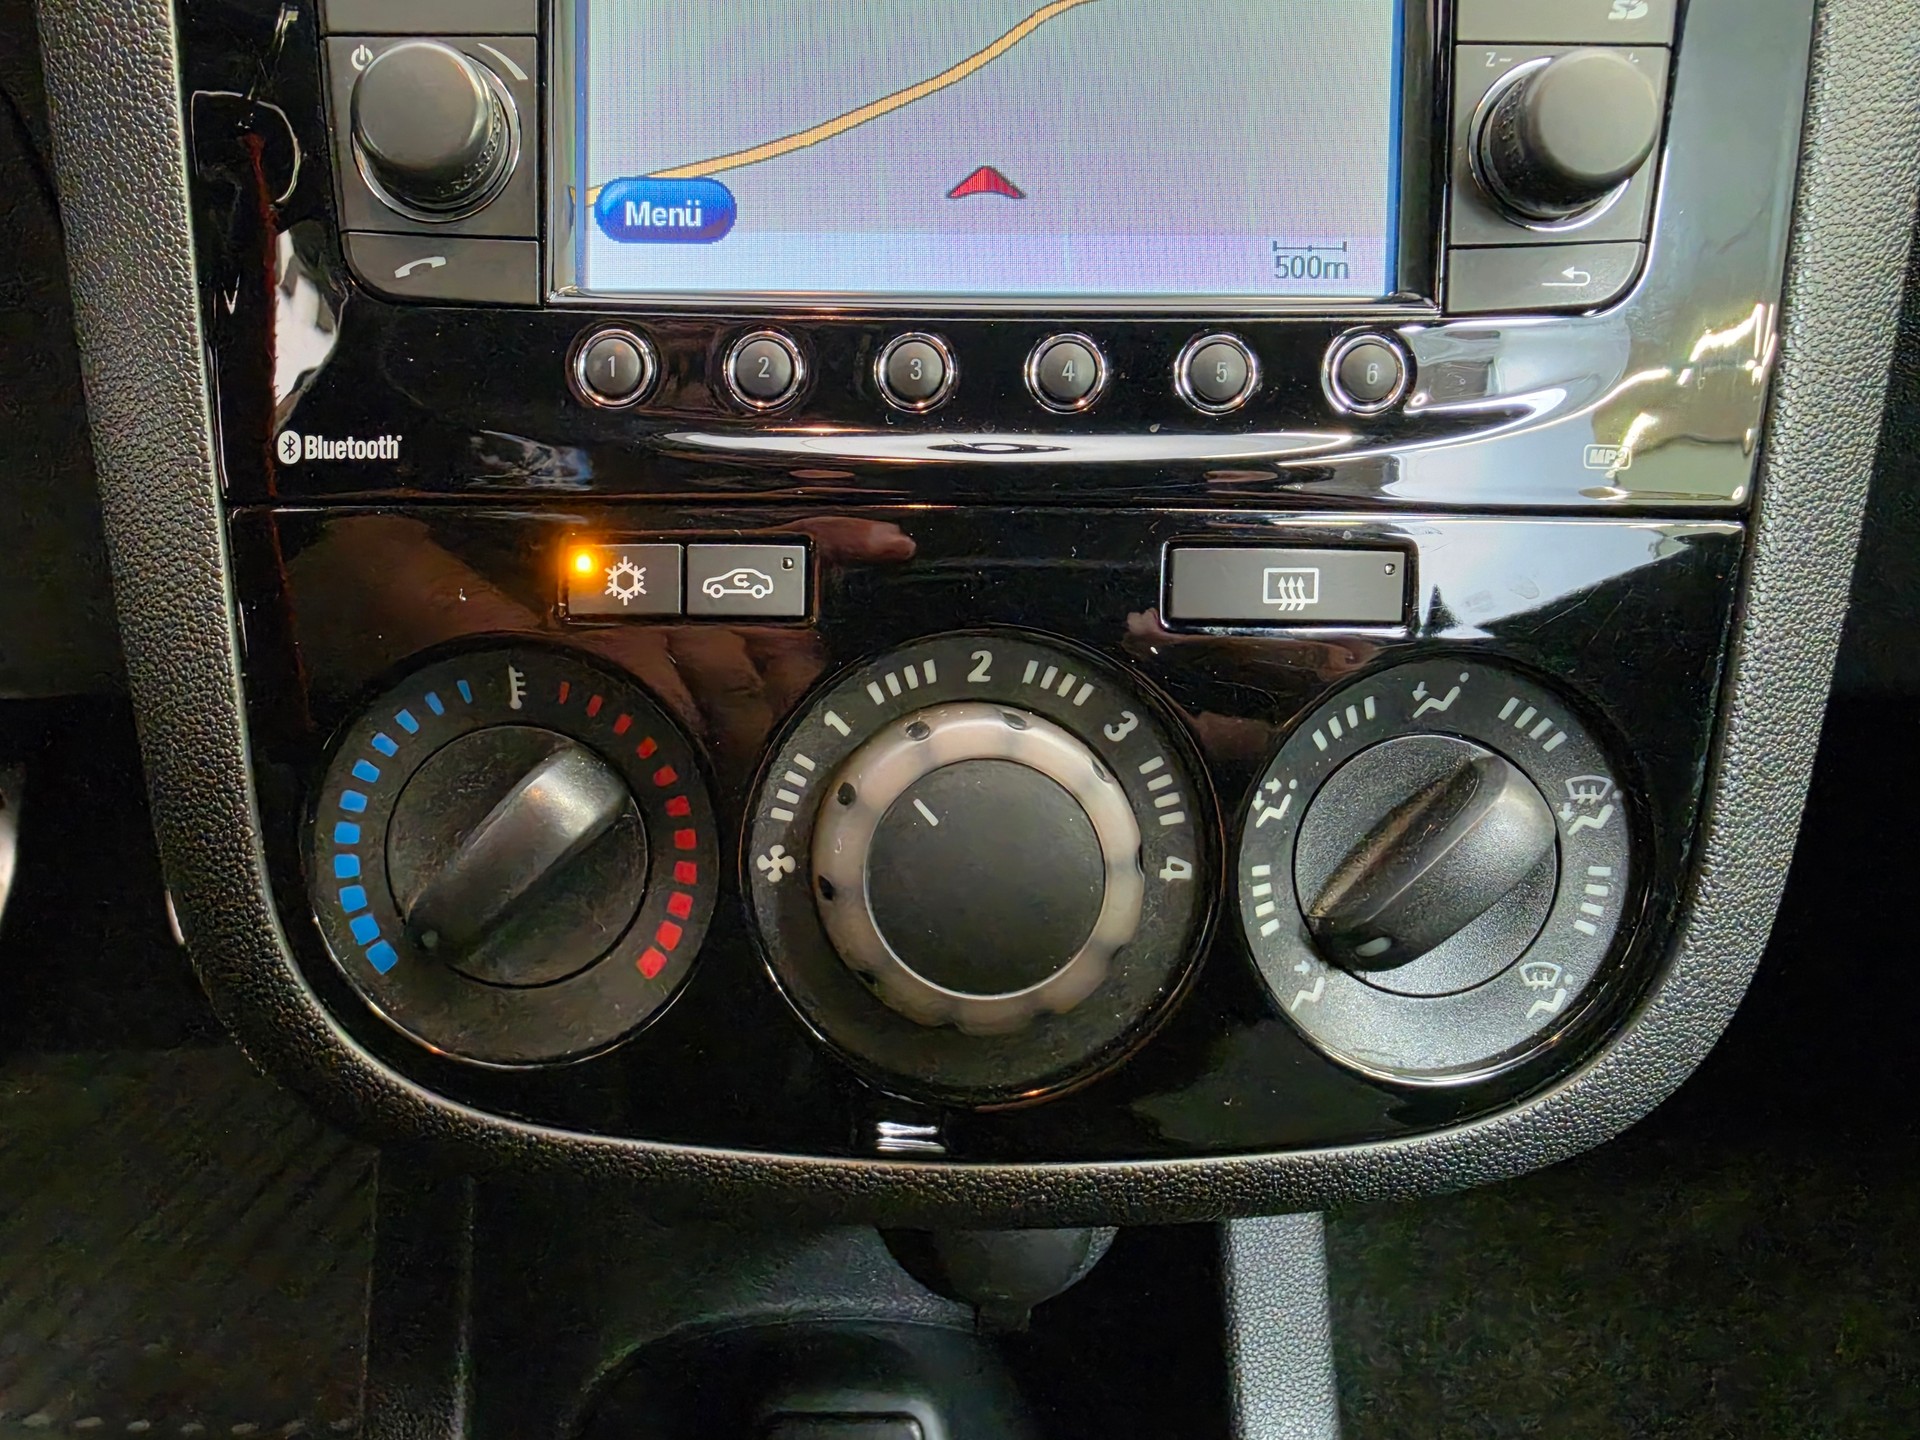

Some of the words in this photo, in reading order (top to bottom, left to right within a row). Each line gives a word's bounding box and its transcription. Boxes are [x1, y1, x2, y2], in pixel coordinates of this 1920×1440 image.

[625, 200, 702, 228] Menü
[1274, 254, 1350, 280] 500m
[607, 356, 617, 378] 1
[758, 356, 771, 378] 2
[910, 358, 922, 380] 3
[1061, 359, 1075, 382] 4
[1215, 361, 1228, 383] 5
[1366, 362, 1379, 384] 6
[967, 650, 992, 683] 2
[824, 710, 852, 737] 1
[1104, 710, 1139, 742] 3
[1159, 856, 1193, 881] 4
